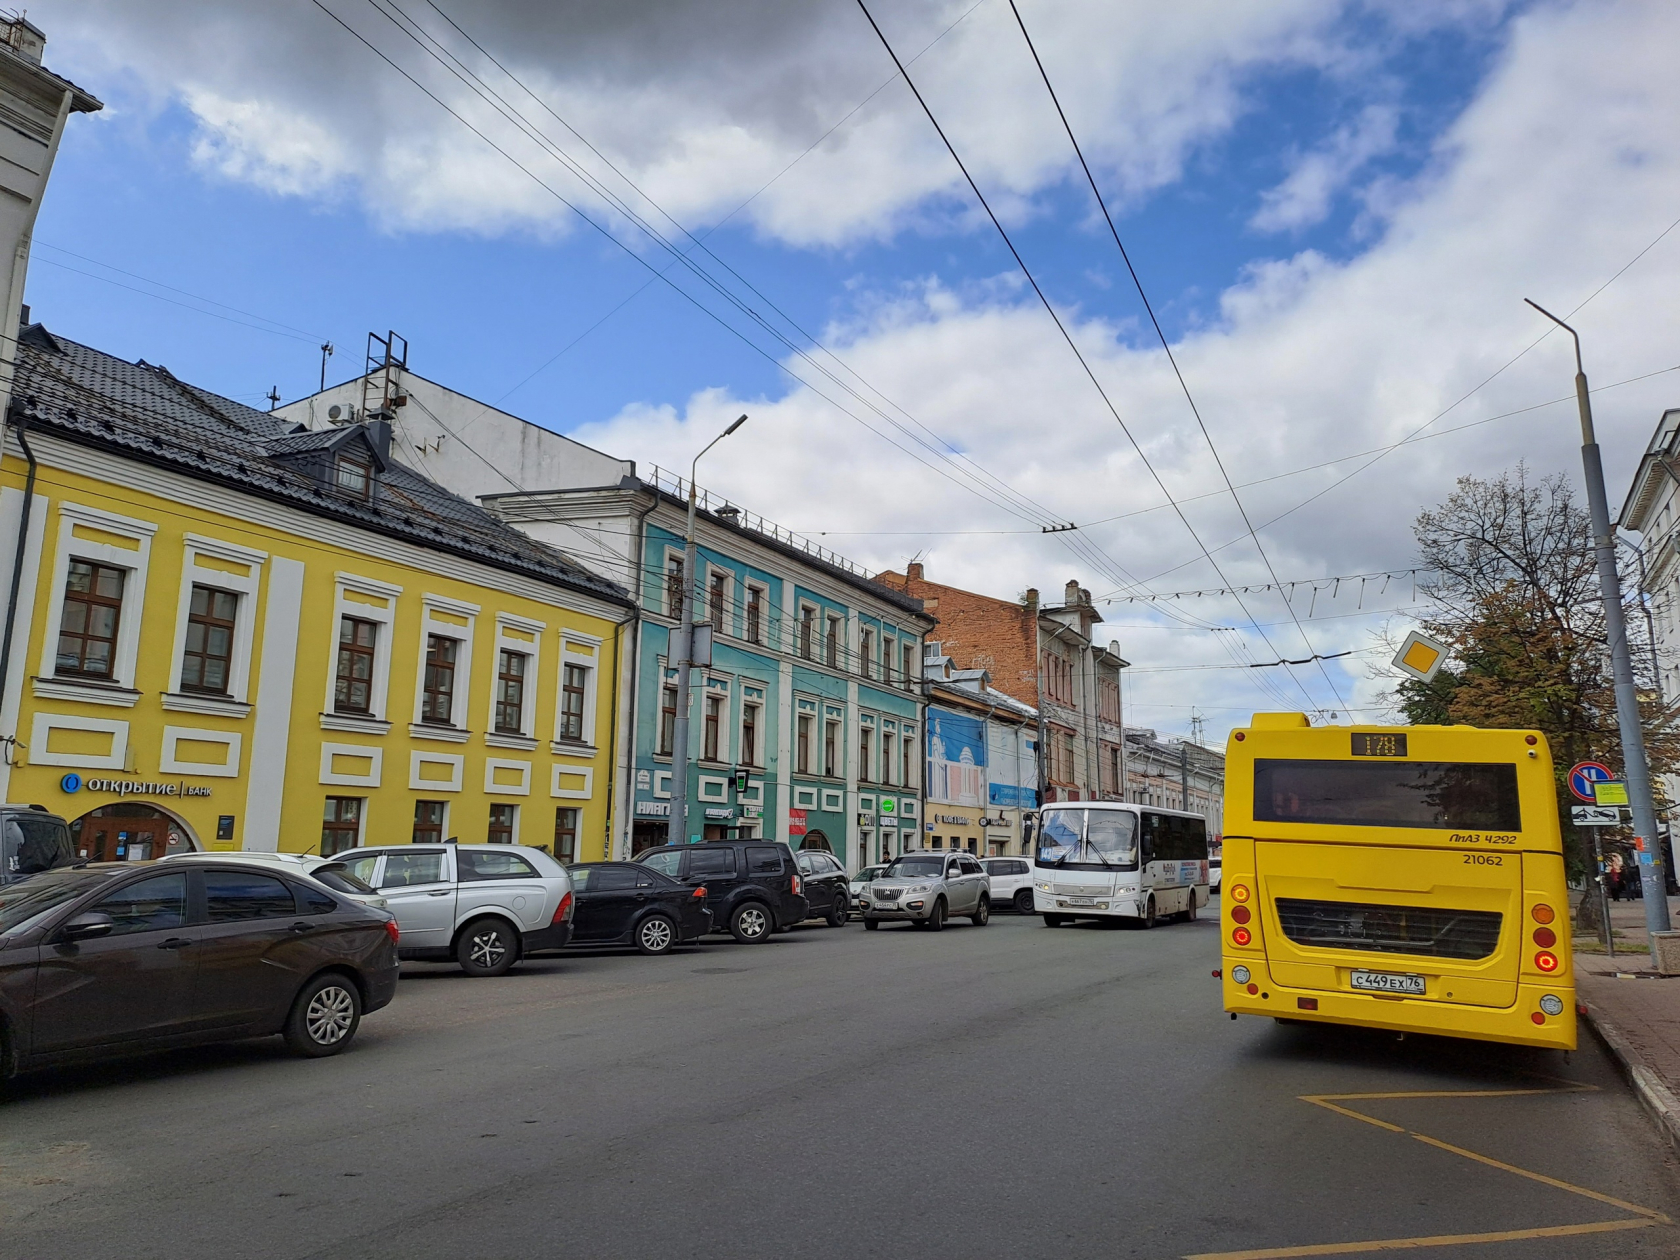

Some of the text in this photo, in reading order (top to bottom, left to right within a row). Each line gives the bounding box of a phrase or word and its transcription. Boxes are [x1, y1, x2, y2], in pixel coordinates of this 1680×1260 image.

[1365, 735, 1396, 756] 178
[88, 778, 213, 797] открытие БАНК
[1485, 834, 1517, 845] 4292
[1041, 847, 1052, 860] 143
[1463, 854, 1503, 867] 21062
